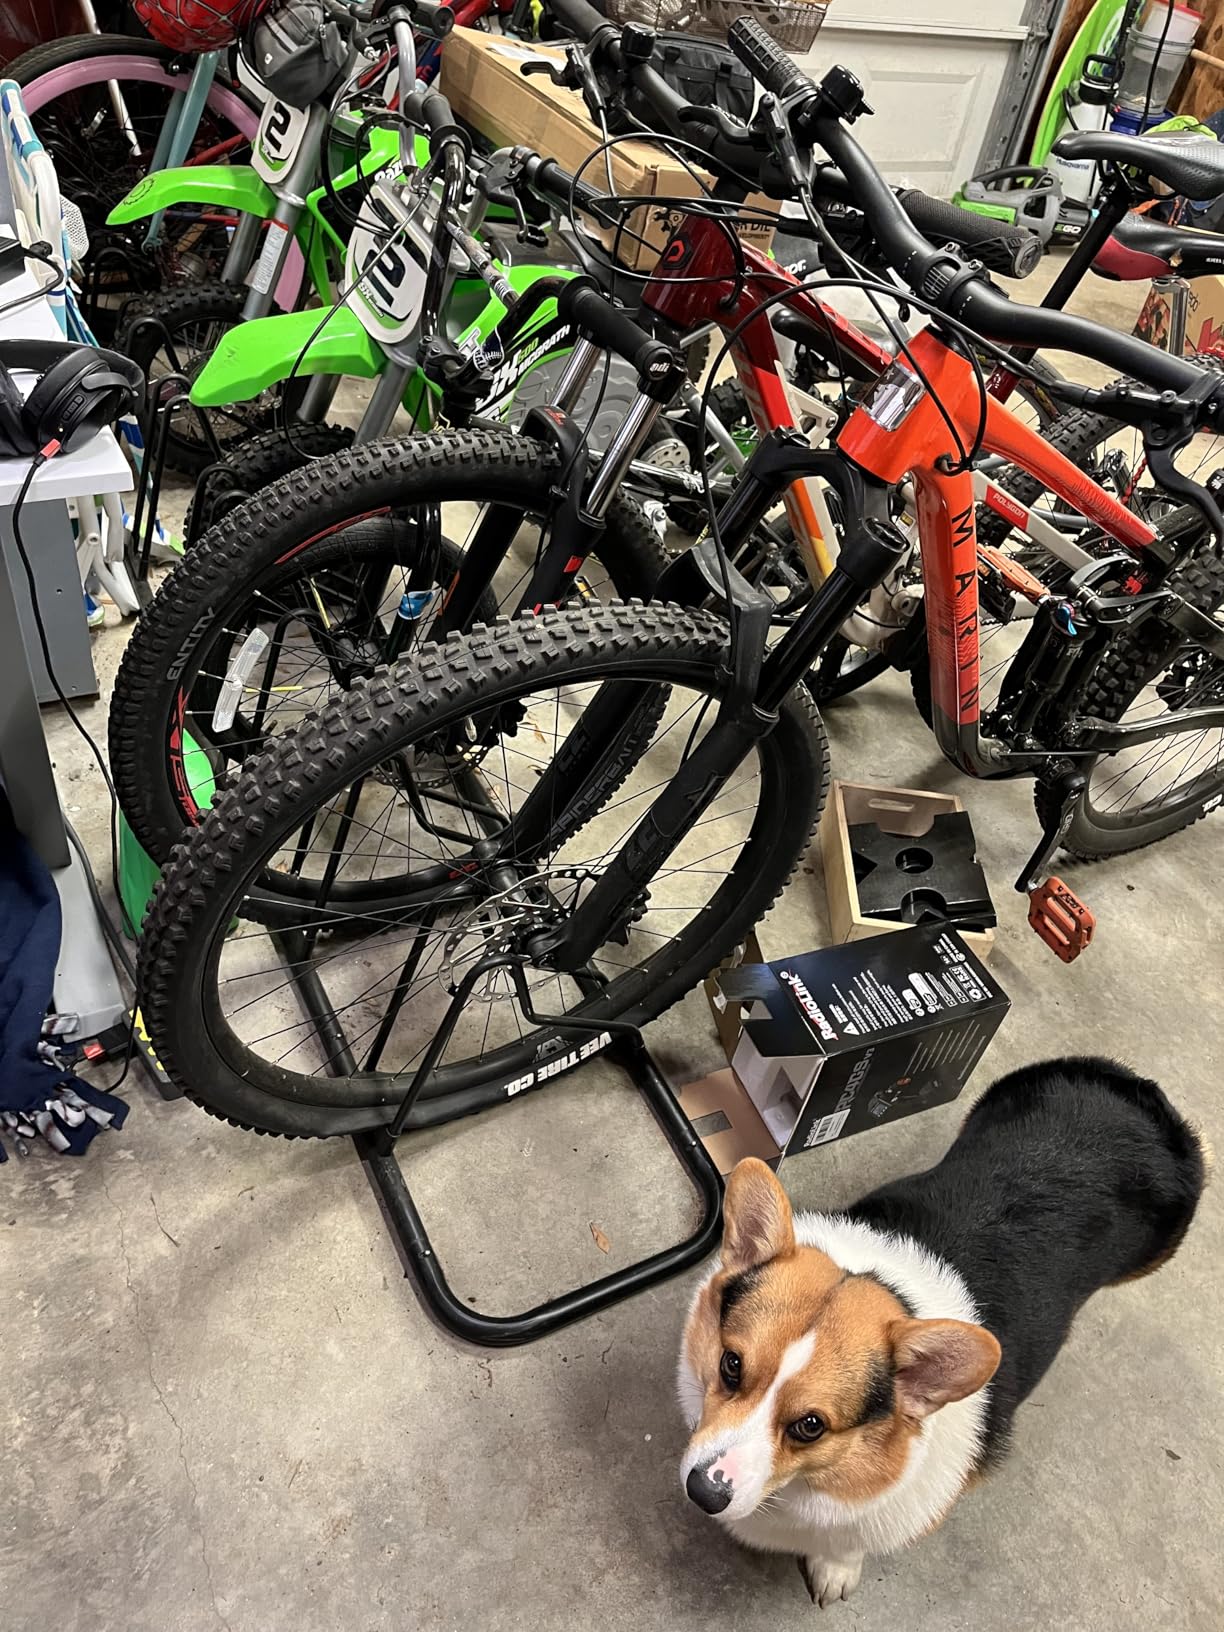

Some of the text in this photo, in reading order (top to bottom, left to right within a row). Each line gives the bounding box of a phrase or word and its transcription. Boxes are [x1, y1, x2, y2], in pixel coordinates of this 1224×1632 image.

[166, 606, 215, 680] ENTITY
[952, 504, 980, 713] MARIN
[503, 1031, 613, 1097] VEE TIRE CO.
